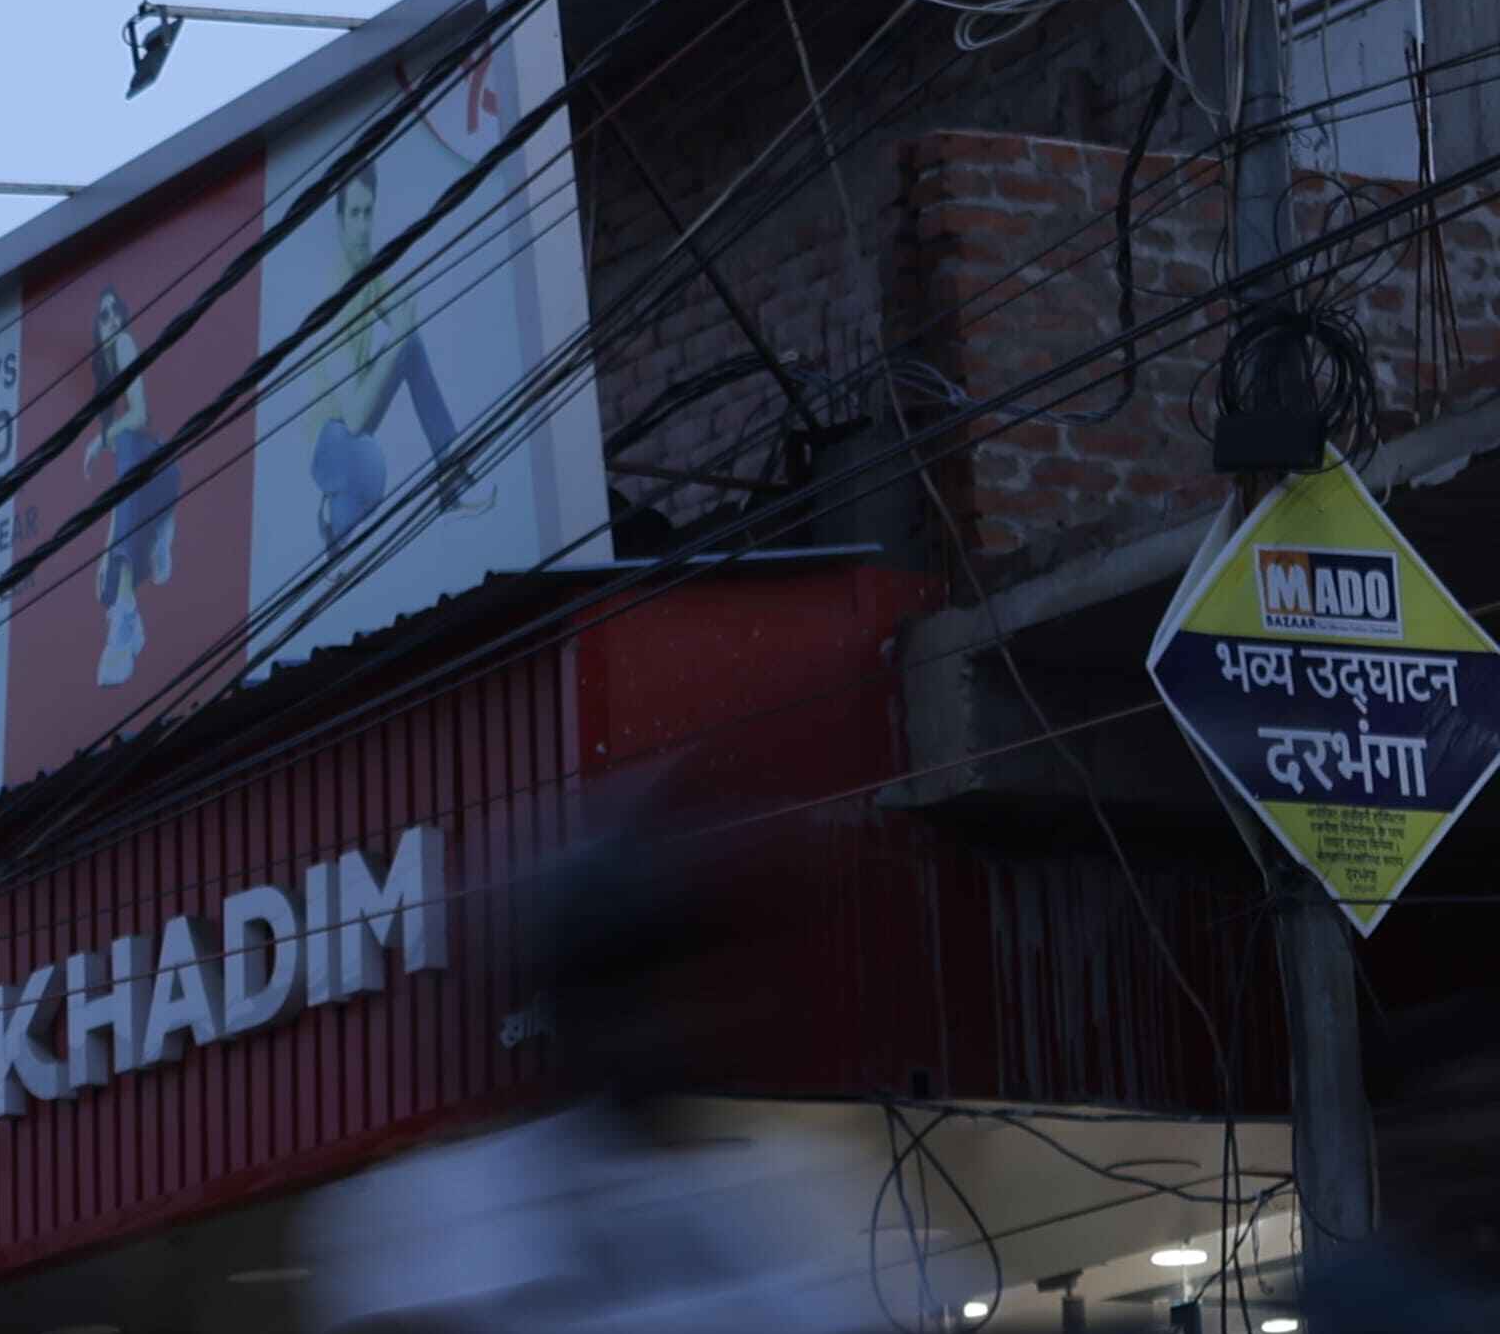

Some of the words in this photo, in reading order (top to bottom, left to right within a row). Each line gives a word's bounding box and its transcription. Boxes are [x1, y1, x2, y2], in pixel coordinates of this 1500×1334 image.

[1266, 563, 1391, 619] MADO
[1266, 616, 1317, 629] BAZAAR
[1215, 642, 1295, 696] भव्य
[1301, 648, 1459, 714] उद्घाटन
[1258, 716, 1428, 798] दरभंगा
